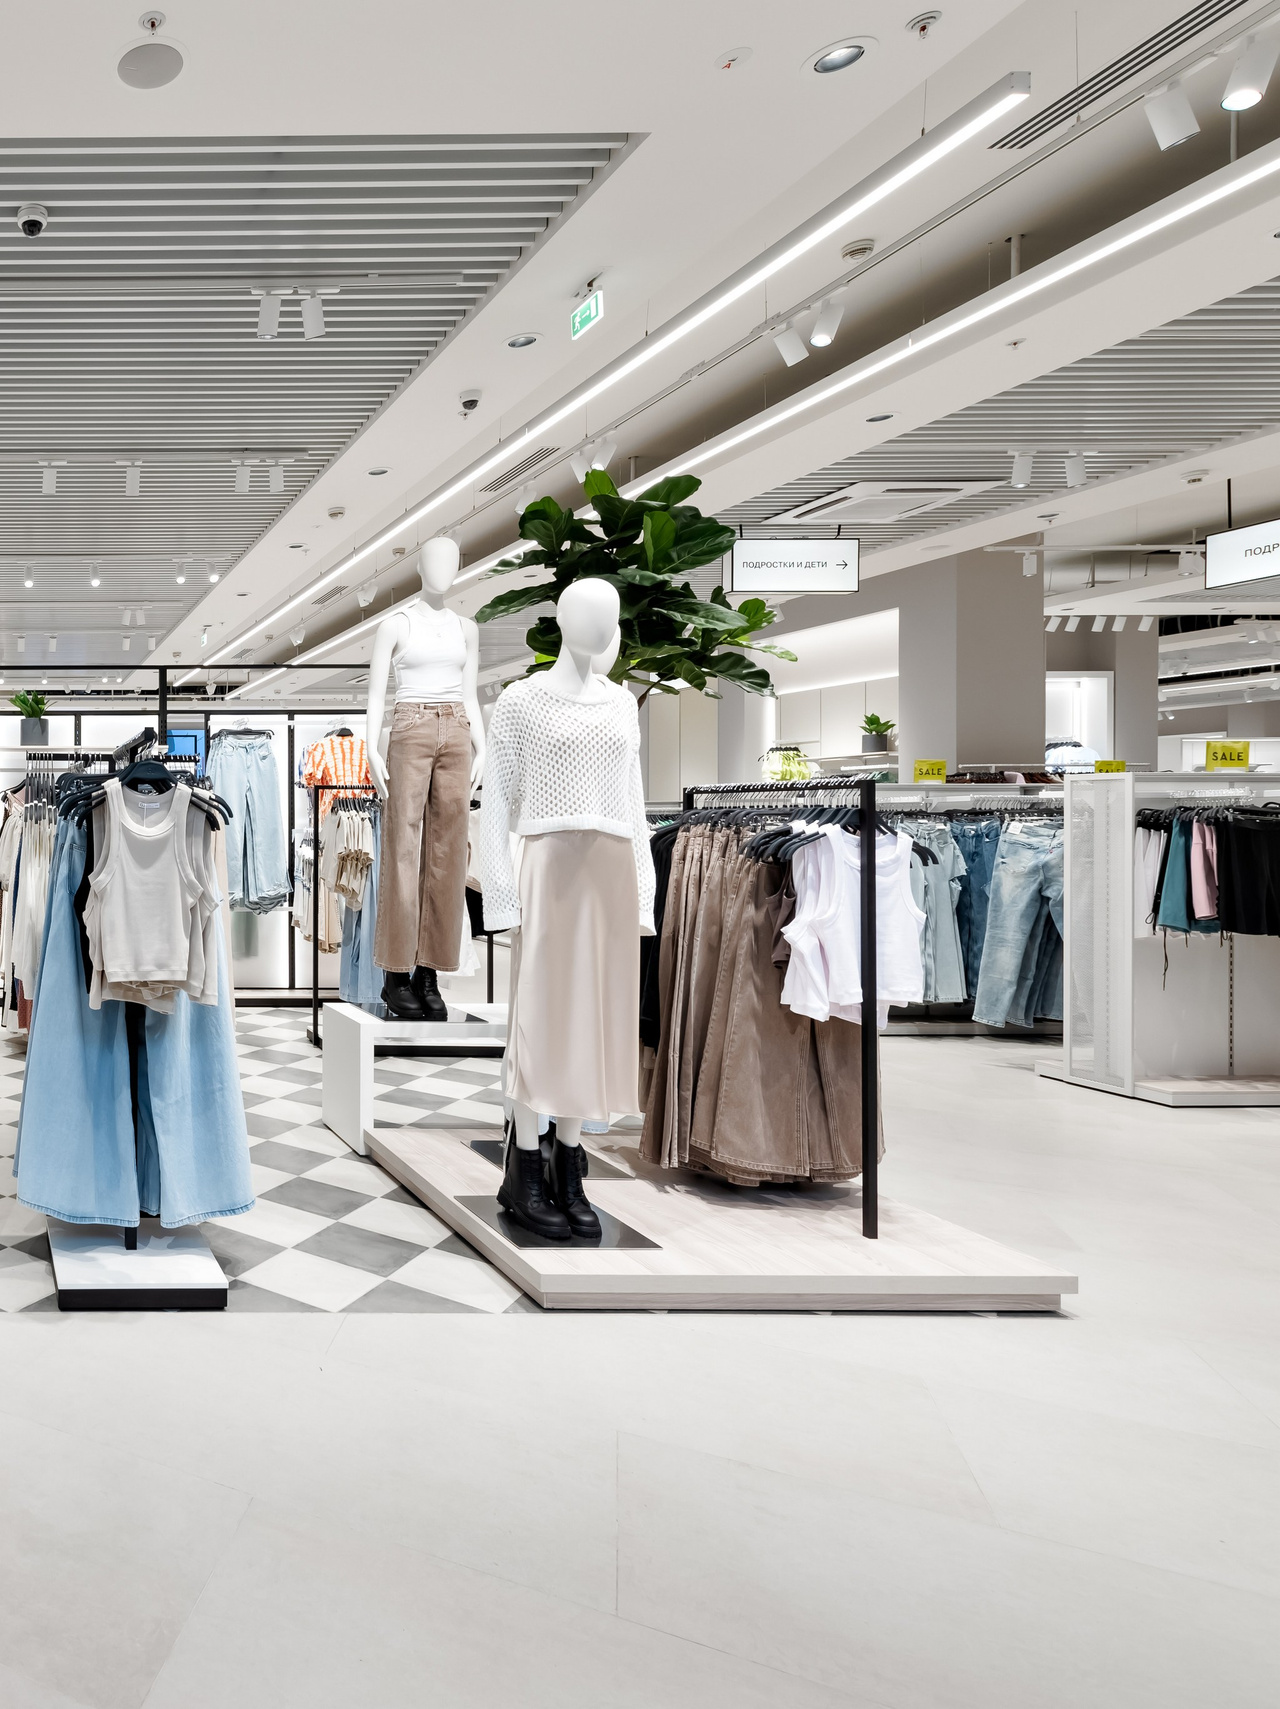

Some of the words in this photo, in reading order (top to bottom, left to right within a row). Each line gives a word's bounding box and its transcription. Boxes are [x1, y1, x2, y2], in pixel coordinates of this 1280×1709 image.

[1244, 542, 1280, 558] ПОДР
[742, 561, 795, 569] ПОДРОСТКИ
[804, 561, 828, 569] ДЕТИ
[1211, 751, 1244, 761] SALE
[918, 767, 943, 776] SALE
